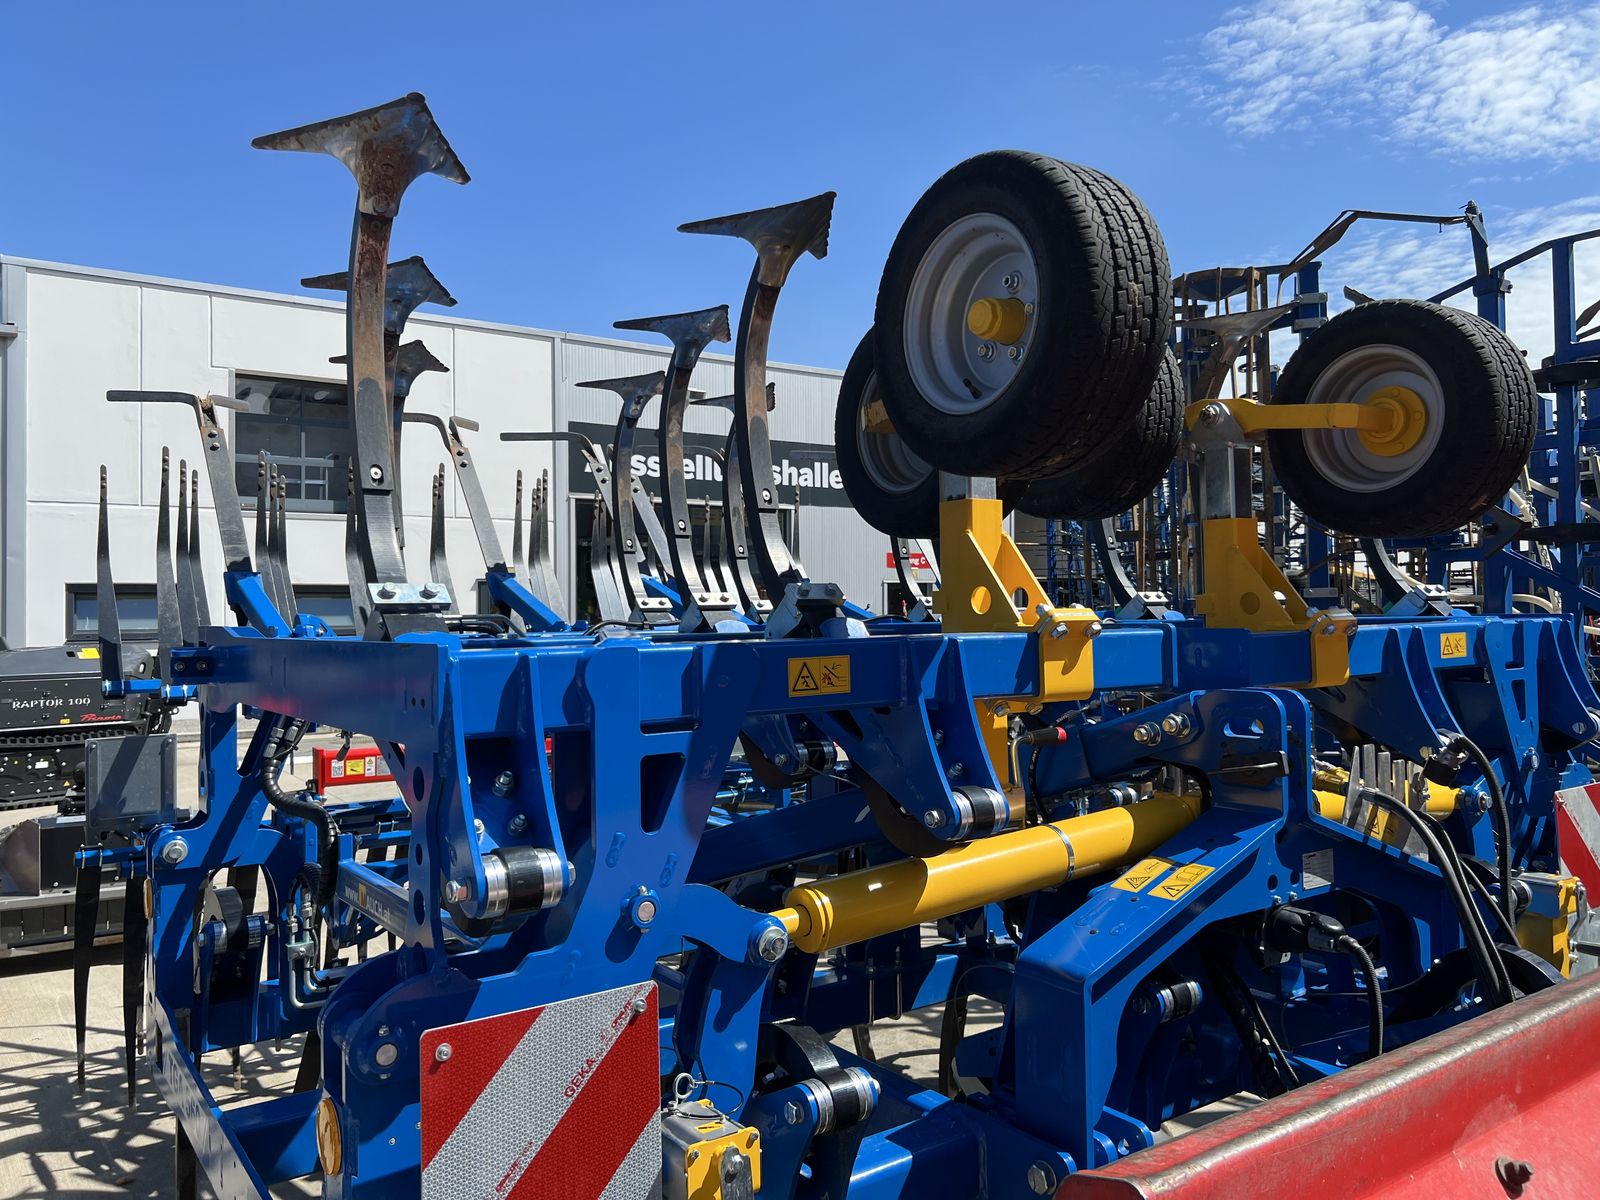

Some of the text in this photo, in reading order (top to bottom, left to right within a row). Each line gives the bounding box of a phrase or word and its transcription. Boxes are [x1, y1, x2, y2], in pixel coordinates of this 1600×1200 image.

[12, 697, 91, 709] RAPTOR 100
[564, 1058, 597, 1098] GEKA
